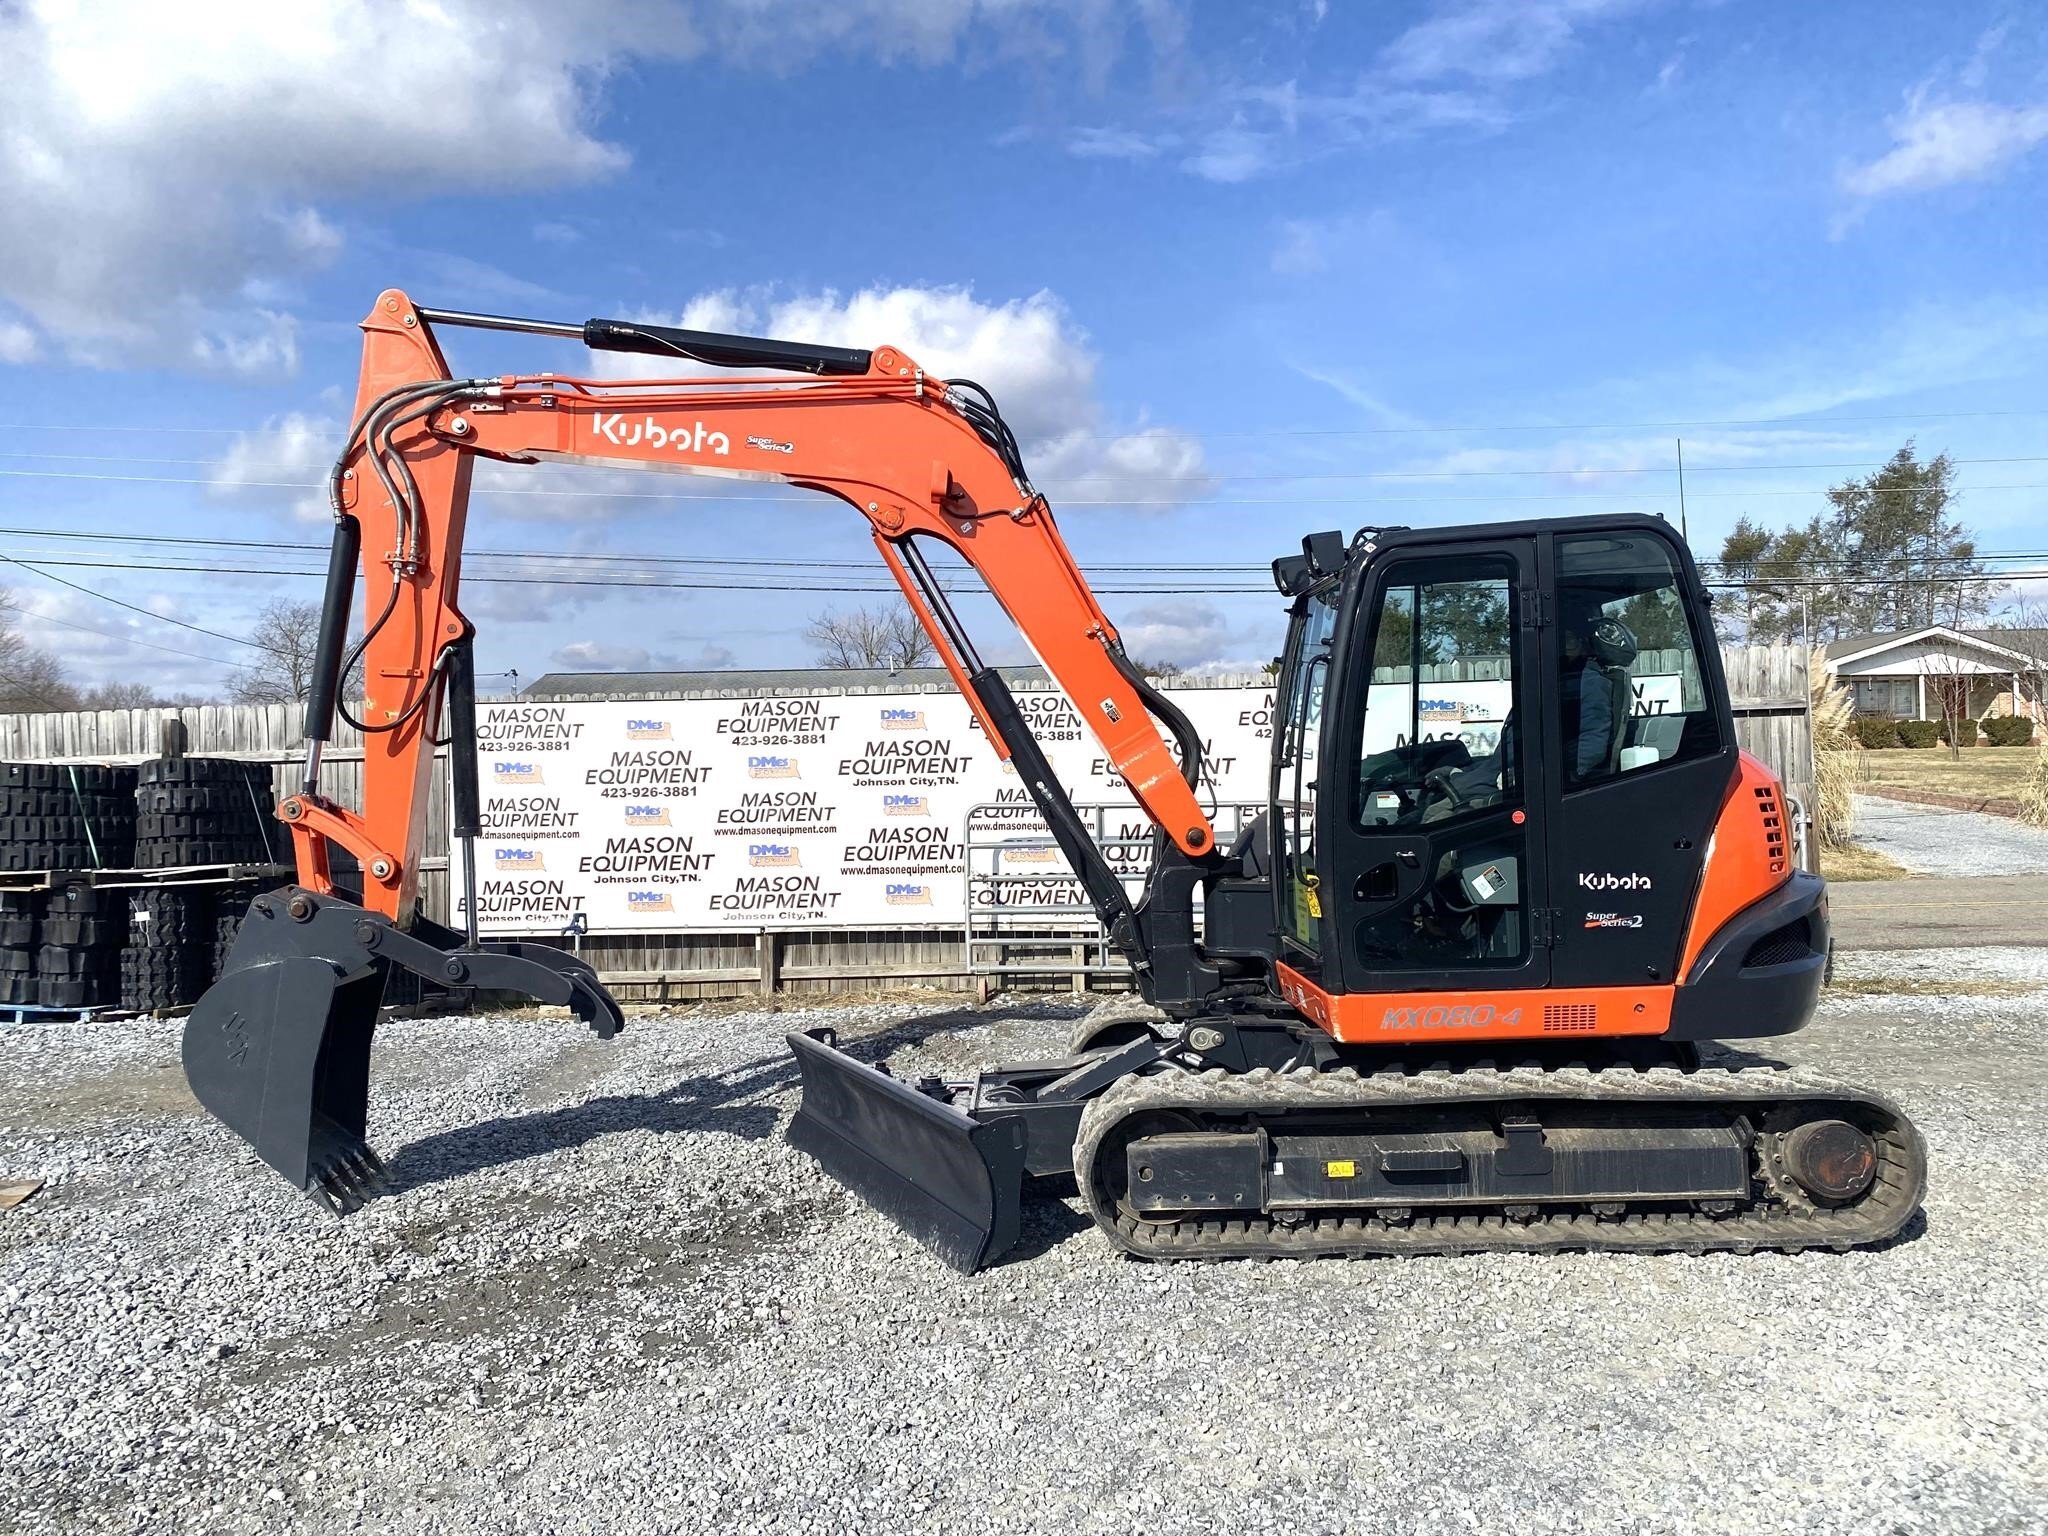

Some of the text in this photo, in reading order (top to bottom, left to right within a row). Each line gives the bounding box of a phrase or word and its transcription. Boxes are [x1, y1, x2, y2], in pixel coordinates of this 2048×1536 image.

[592, 411, 730, 456] Kubota
[741, 701, 820, 716] MASON
[1009, 698, 1075, 712] ASON
[488, 708, 565, 723] MASON
[477, 724, 584, 739] QUIPMENT
[716, 716, 839, 733] EQUIPMENT
[479, 741, 570, 751] 423-926-3881
[732, 734, 826, 745] 423-926-3881
[865, 740, 950, 757] MASON
[611, 750, 692, 766] MASON
[838, 757, 972, 775] EQUIPMENT
[585, 767, 712, 785] EQUIPMENT
[853, 777, 959, 786] Johnson City,TN.
[601, 787, 697, 798] 423-926-3881
[741, 792, 816, 807] MASON
[488, 798, 560, 811] MASON
[480, 813, 578, 827] QUIPMENT
[718, 807, 836, 823] EQUIPMENT
[477, 830, 580, 840] .dmasonequipment.com
[714, 825, 836, 836] www.dmasonequipment.com
[869, 827, 948, 843] MASON
[606, 837, 692, 853] MASON
[844, 844, 964, 861] EQUIPMENT
[579, 854, 715, 872] EQUIPMENT
[594, 874, 701, 883] Johnson City,TN.
[736, 876, 820, 892] MASON
[1578, 872, 1652, 890] Kubota
[483, 880, 563, 895] MASON
[709, 893, 841, 910] EQUIPMENT
[478, 914, 521, 922] ohnson
[723, 912, 775, 920] Johnson
[1585, 912, 1618, 923] Super
